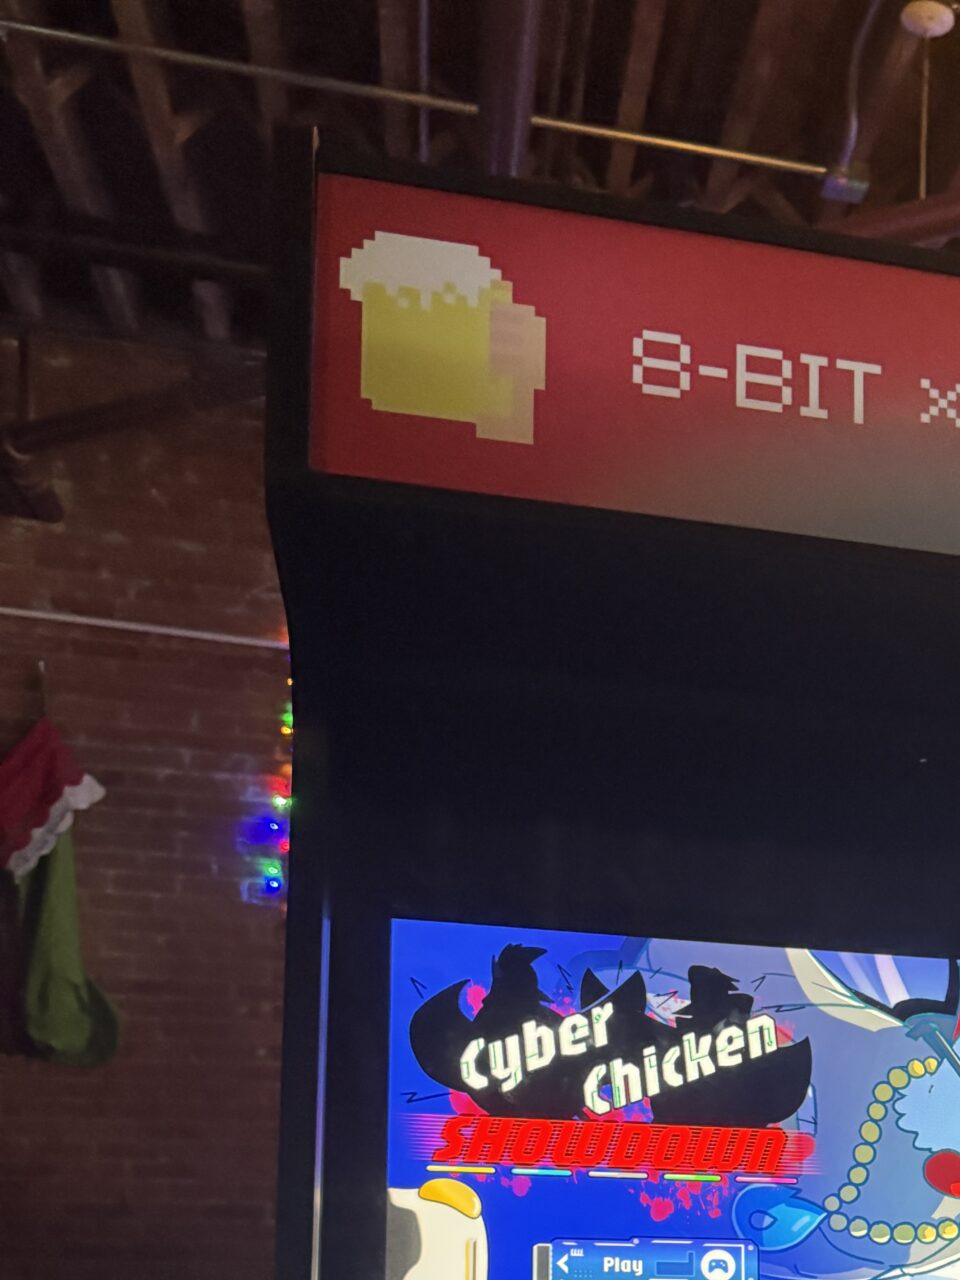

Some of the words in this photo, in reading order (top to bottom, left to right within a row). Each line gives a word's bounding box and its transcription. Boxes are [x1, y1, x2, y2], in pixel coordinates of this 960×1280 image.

[632, 328, 882, 424] 8-BIT
[460, 1001, 614, 1092] Cyber
[583, 1013, 778, 1115] Chicken
[432, 1115, 789, 1174] SHOWDOWN
[603, 1256, 643, 1276] Play
